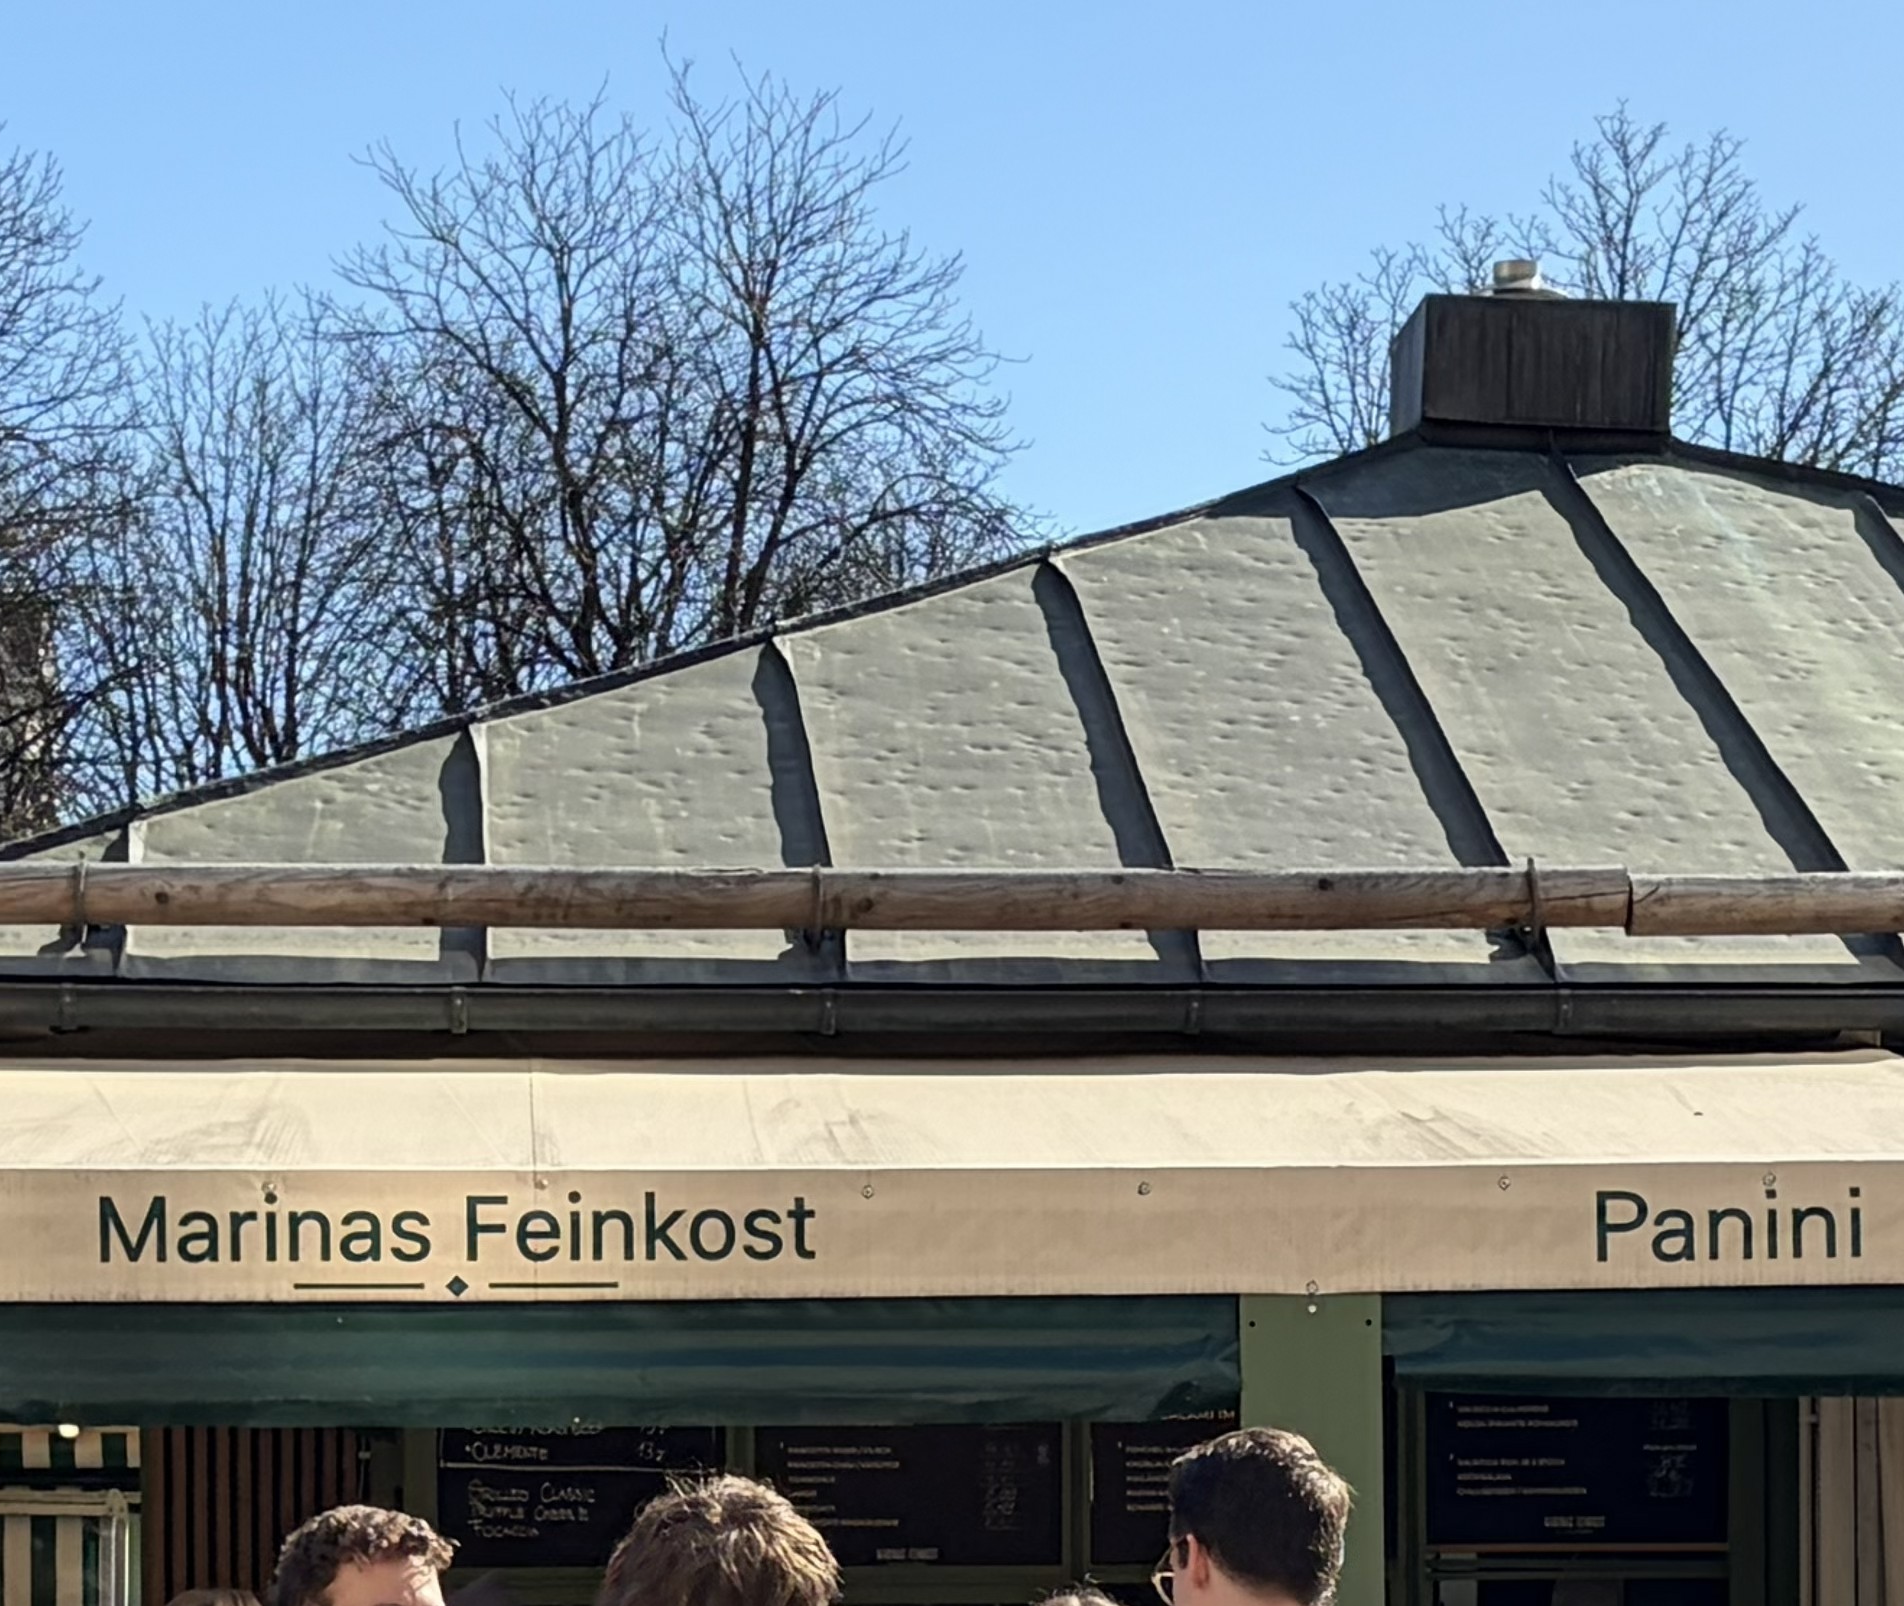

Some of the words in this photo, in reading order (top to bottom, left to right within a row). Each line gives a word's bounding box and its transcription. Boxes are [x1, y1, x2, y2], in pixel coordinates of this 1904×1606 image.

[98, 1191, 431, 1264] Marinas
[466, 1190, 817, 1263] Feinkost
[1596, 1186, 1862, 1263] Panini
